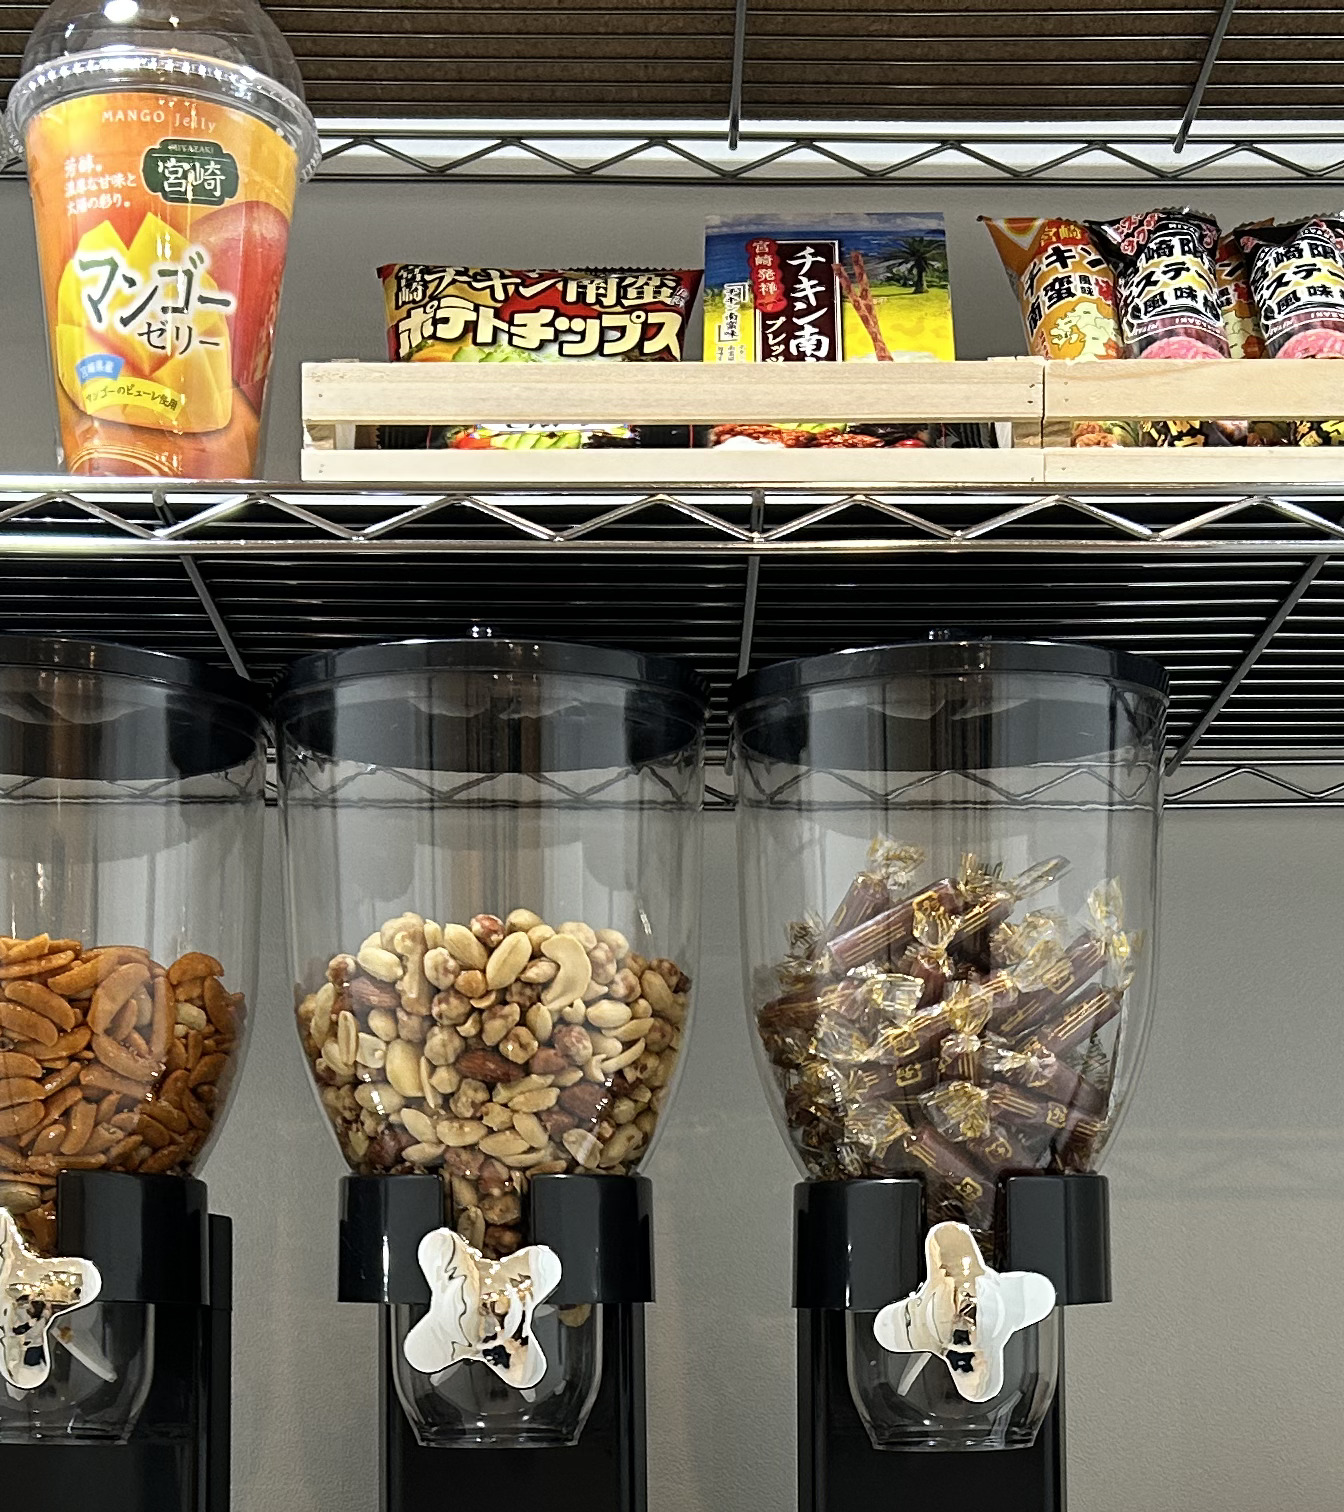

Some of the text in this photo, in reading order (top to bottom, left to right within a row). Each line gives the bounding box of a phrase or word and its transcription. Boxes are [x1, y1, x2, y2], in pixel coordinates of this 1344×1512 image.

[101, 108, 217, 134] MANGO Jelly
[162, 156, 226, 198] 宮崎
[78, 250, 232, 328] マンゴー
[752, 240, 779, 297] 宮崎発祥
[1023, 244, 1107, 298] チキン
[398, 298, 683, 362] ポテトチップス
[785, 245, 831, 362] チキン南
[137, 319, 221, 356] ゼリー
